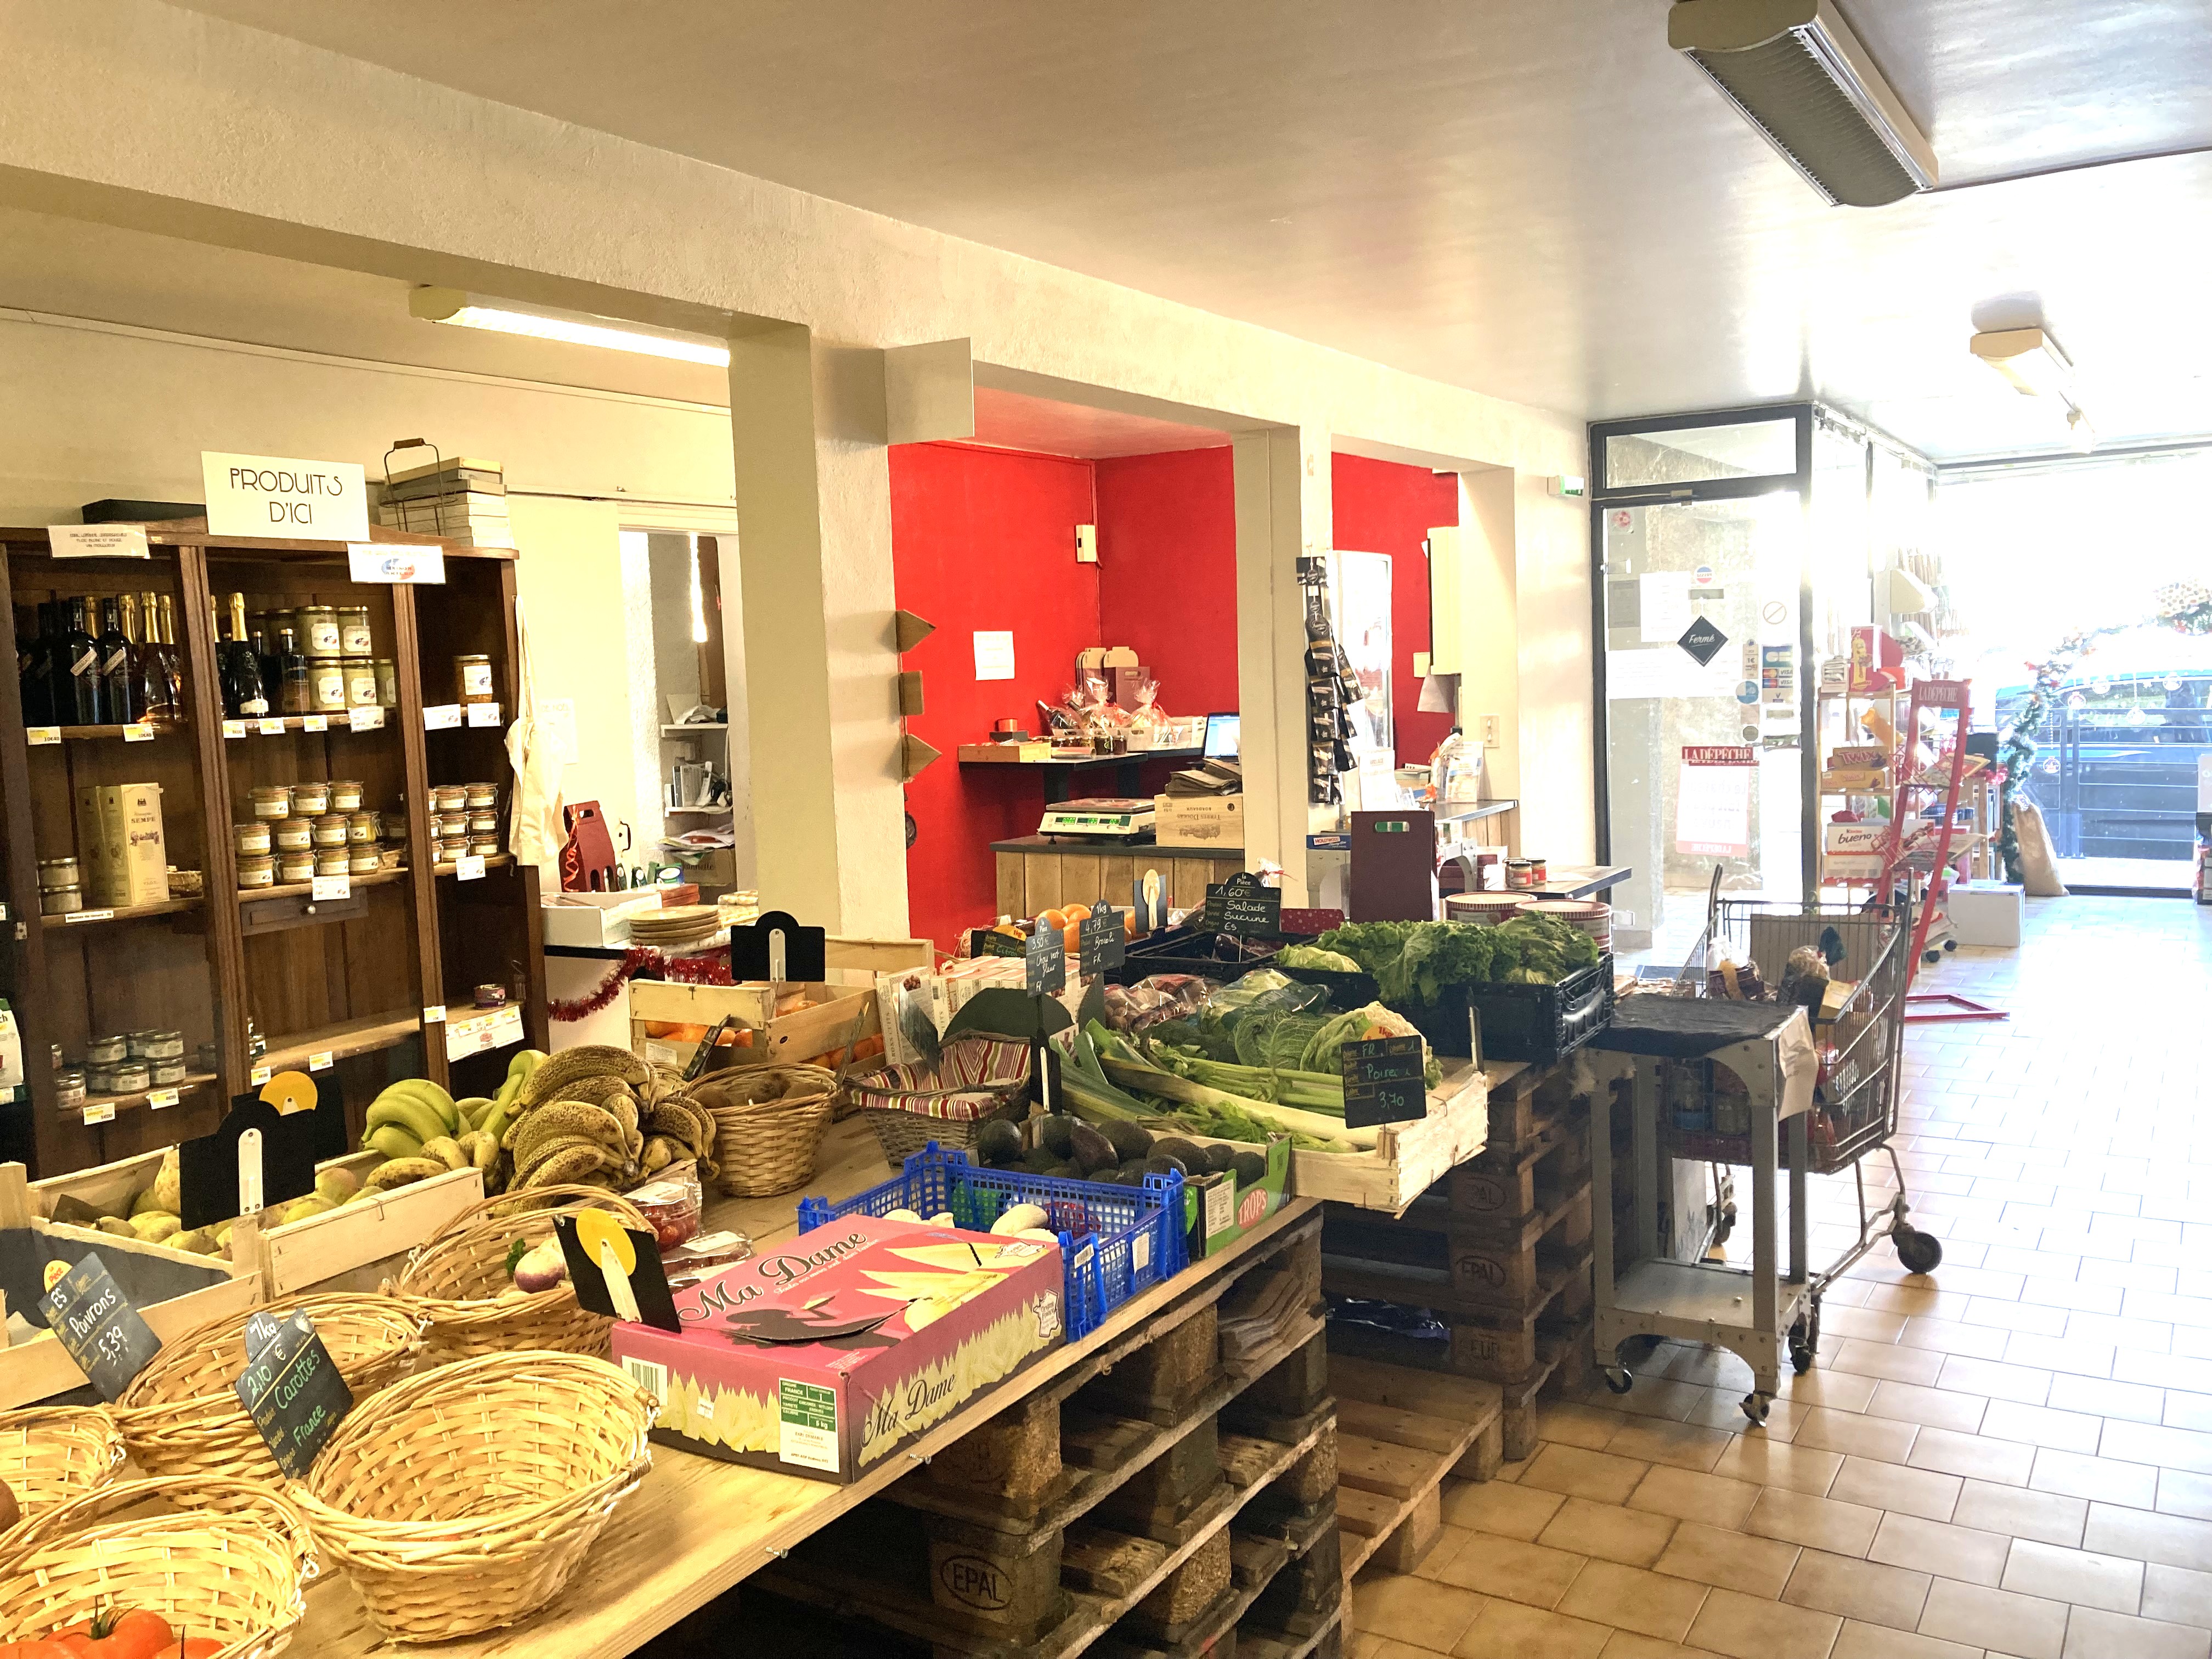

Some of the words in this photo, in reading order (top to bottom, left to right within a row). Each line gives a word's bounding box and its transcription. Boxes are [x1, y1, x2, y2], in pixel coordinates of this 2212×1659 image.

[230, 467, 342, 496] PRODUITS
[269, 501, 312, 524] D'ICI
[1688, 634, 1716, 644] Fermé
[1684, 749, 1698, 760] LA
[1838, 833, 1872, 844] bueno
[1097, 902, 1107, 915] 1kg
[1226, 900, 1266, 913] Salade
[1093, 952, 1102, 966] FR
[1362, 1043, 1375, 1058] FR
[1379, 1091, 1404, 1110] 3,70
[1238, 1188, 1267, 1224] TROPS
[677, 1279, 764, 1322] Ma
[758, 1232, 868, 1286] Dame
[69, 1288, 116, 1339] Poivrons
[247, 1365, 272, 1399] 2,10
[274, 1348, 320, 1409] Carottes
[785, 1387, 803, 1396] FRANCE
[860, 1397, 899, 1448] Ma
[905, 1373, 955, 1420] Dame
[292, 1404, 326, 1447] France
[820, 1420, 828, 1430] kg
[952, 1564, 1004, 1605] EPAL
